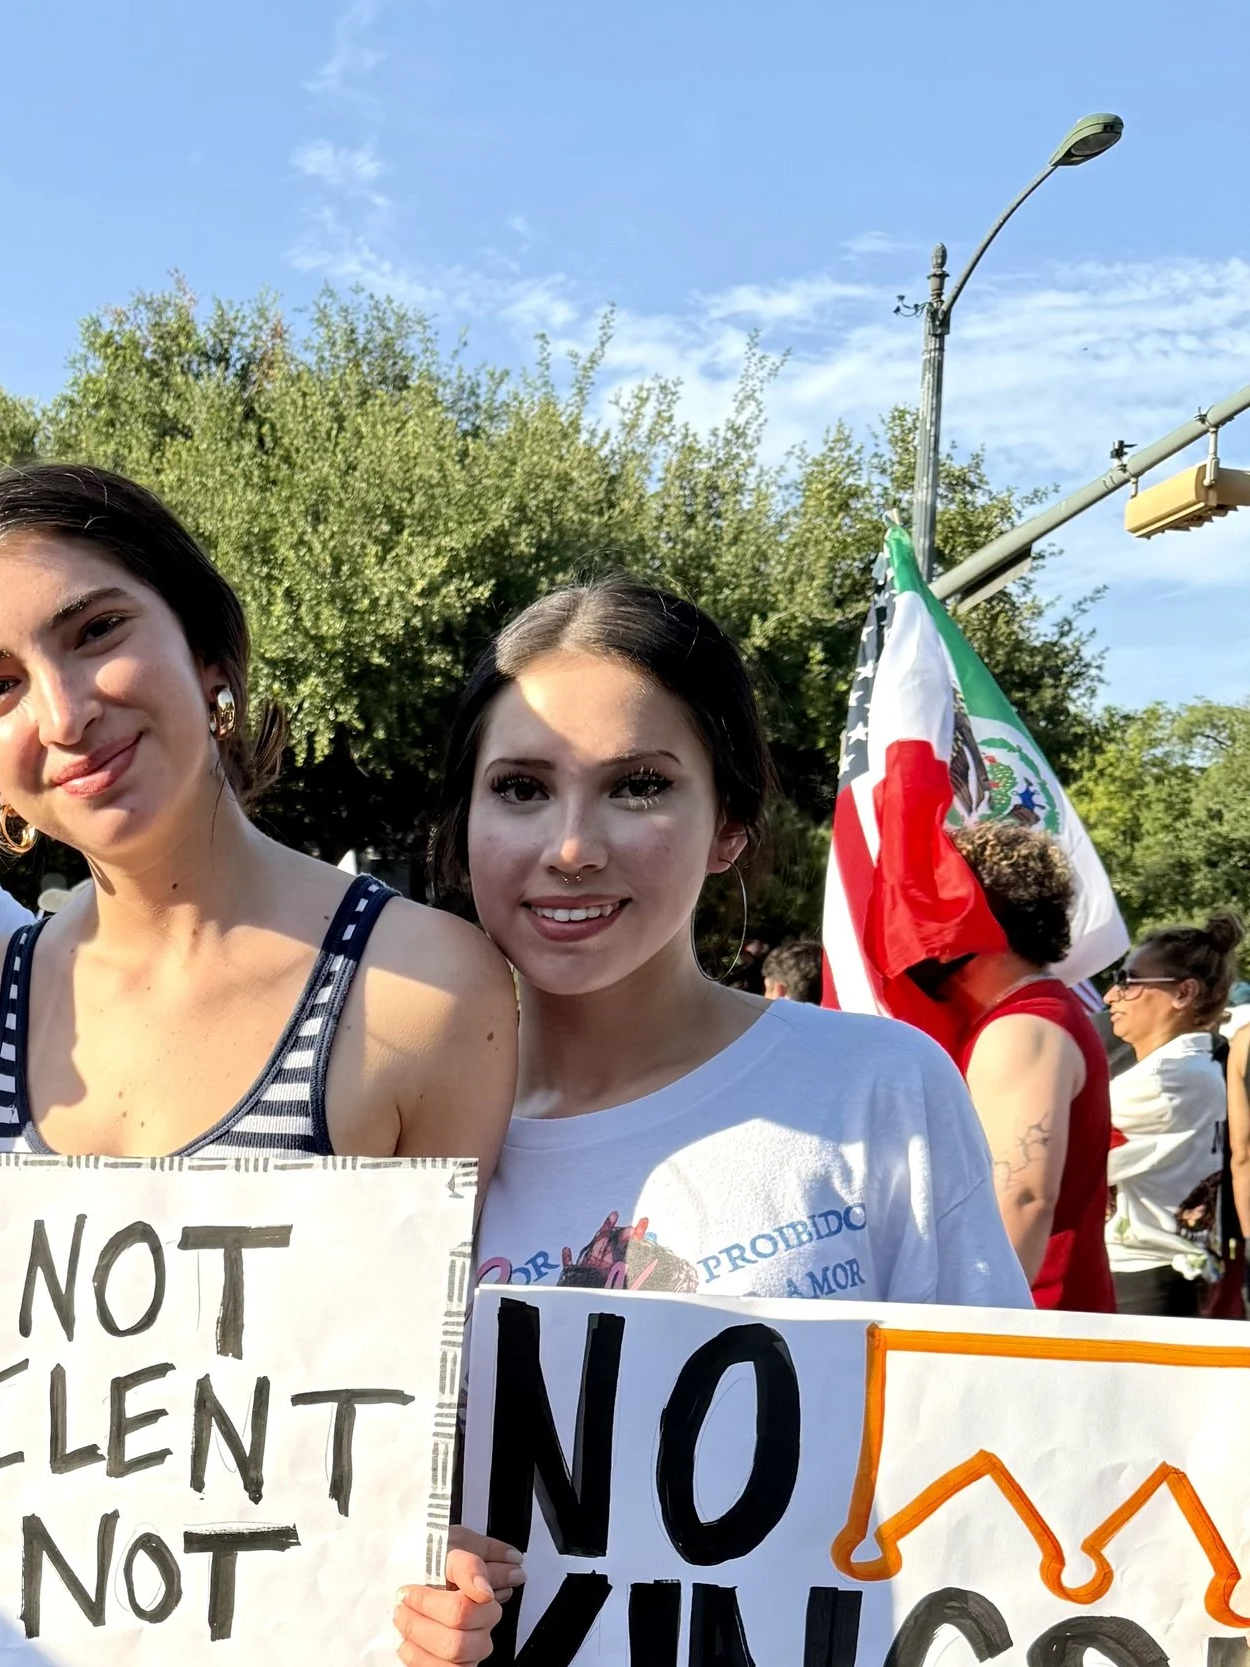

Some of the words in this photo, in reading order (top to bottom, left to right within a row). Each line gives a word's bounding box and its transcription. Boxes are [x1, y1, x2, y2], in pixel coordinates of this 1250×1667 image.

[19, 1213, 293, 1359] NOT
[487, 1297, 802, 1566] NO
[16, 1508, 302, 1642] NOT
